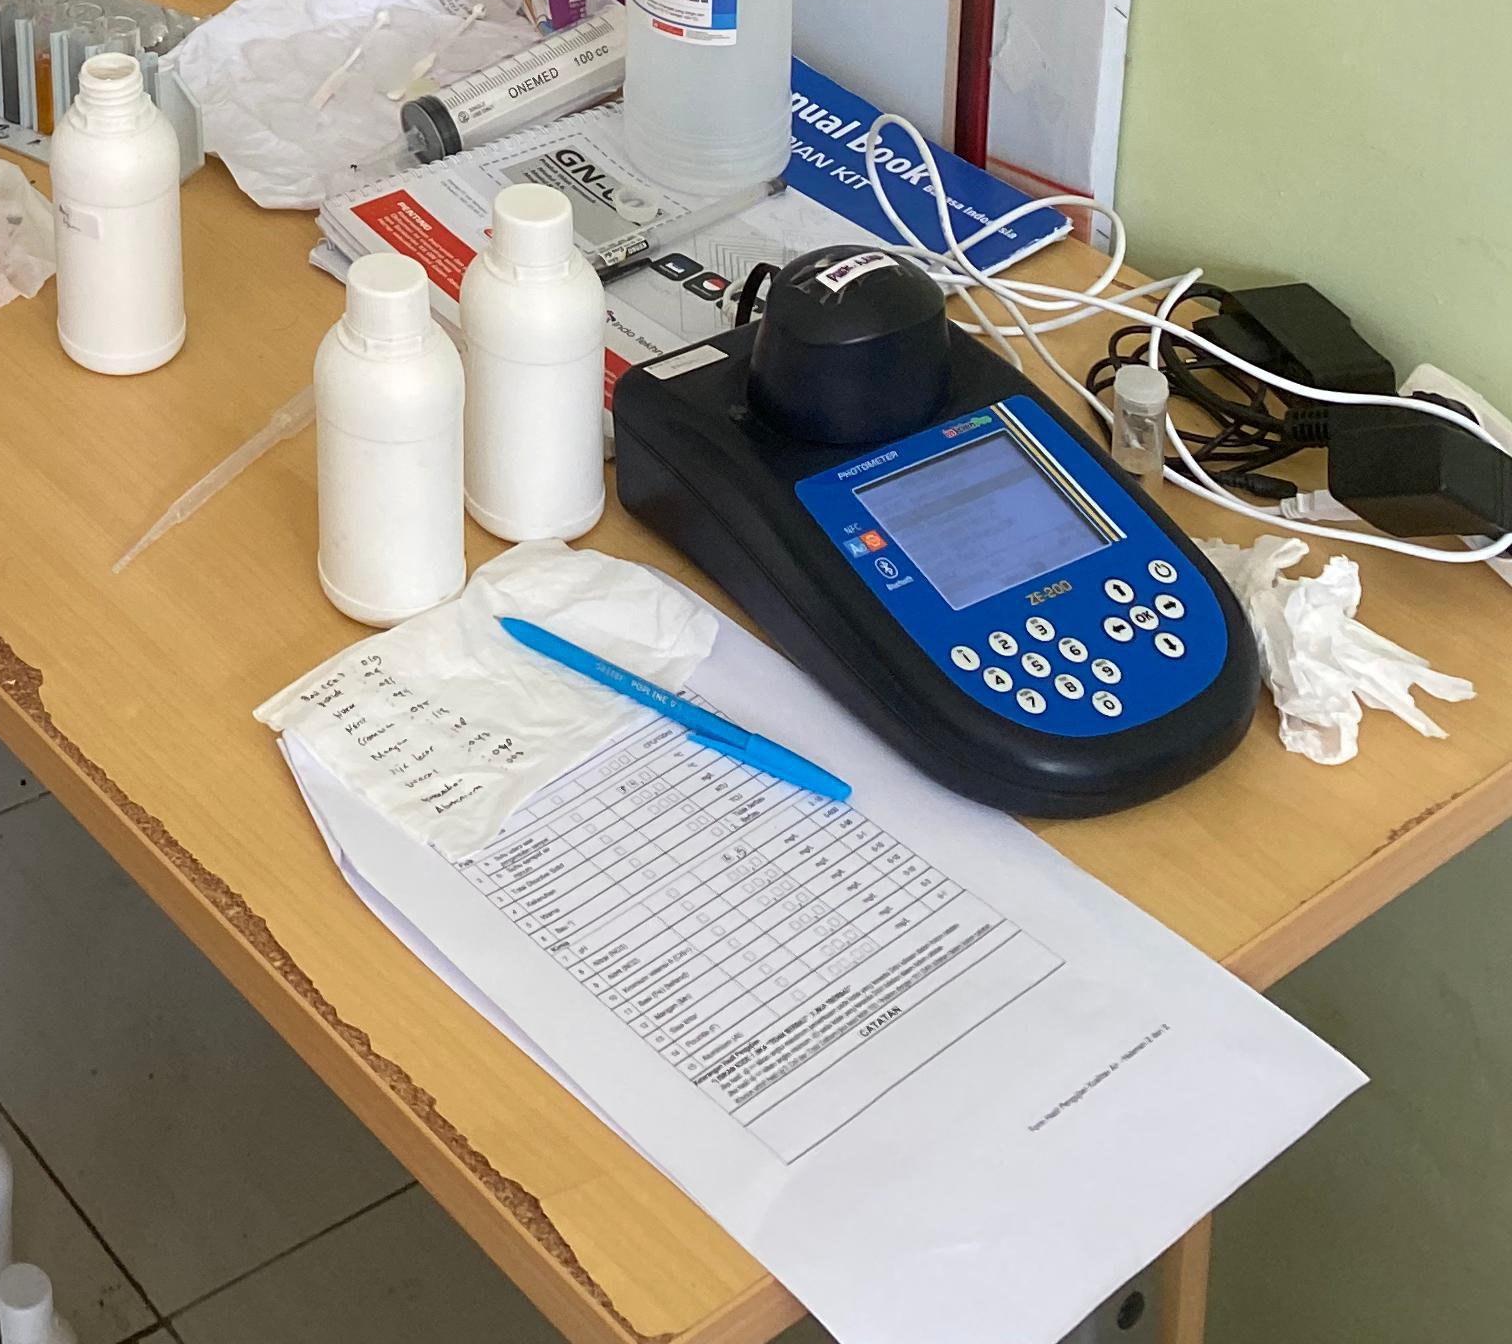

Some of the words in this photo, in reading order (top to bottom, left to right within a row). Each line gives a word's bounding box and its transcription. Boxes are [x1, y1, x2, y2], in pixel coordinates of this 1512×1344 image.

[508, 67, 559, 99] ONEMED
[574, 51, 593, 66] 100
[595, 45, 609, 57] cc
[846, 132, 932, 186] Book
[830, 165, 872, 190] KIT
[838, 450, 899, 481] PHOTOMETER
[1135, 610, 1155, 625] OK
[860, 1004, 903, 1039] CATATAN
